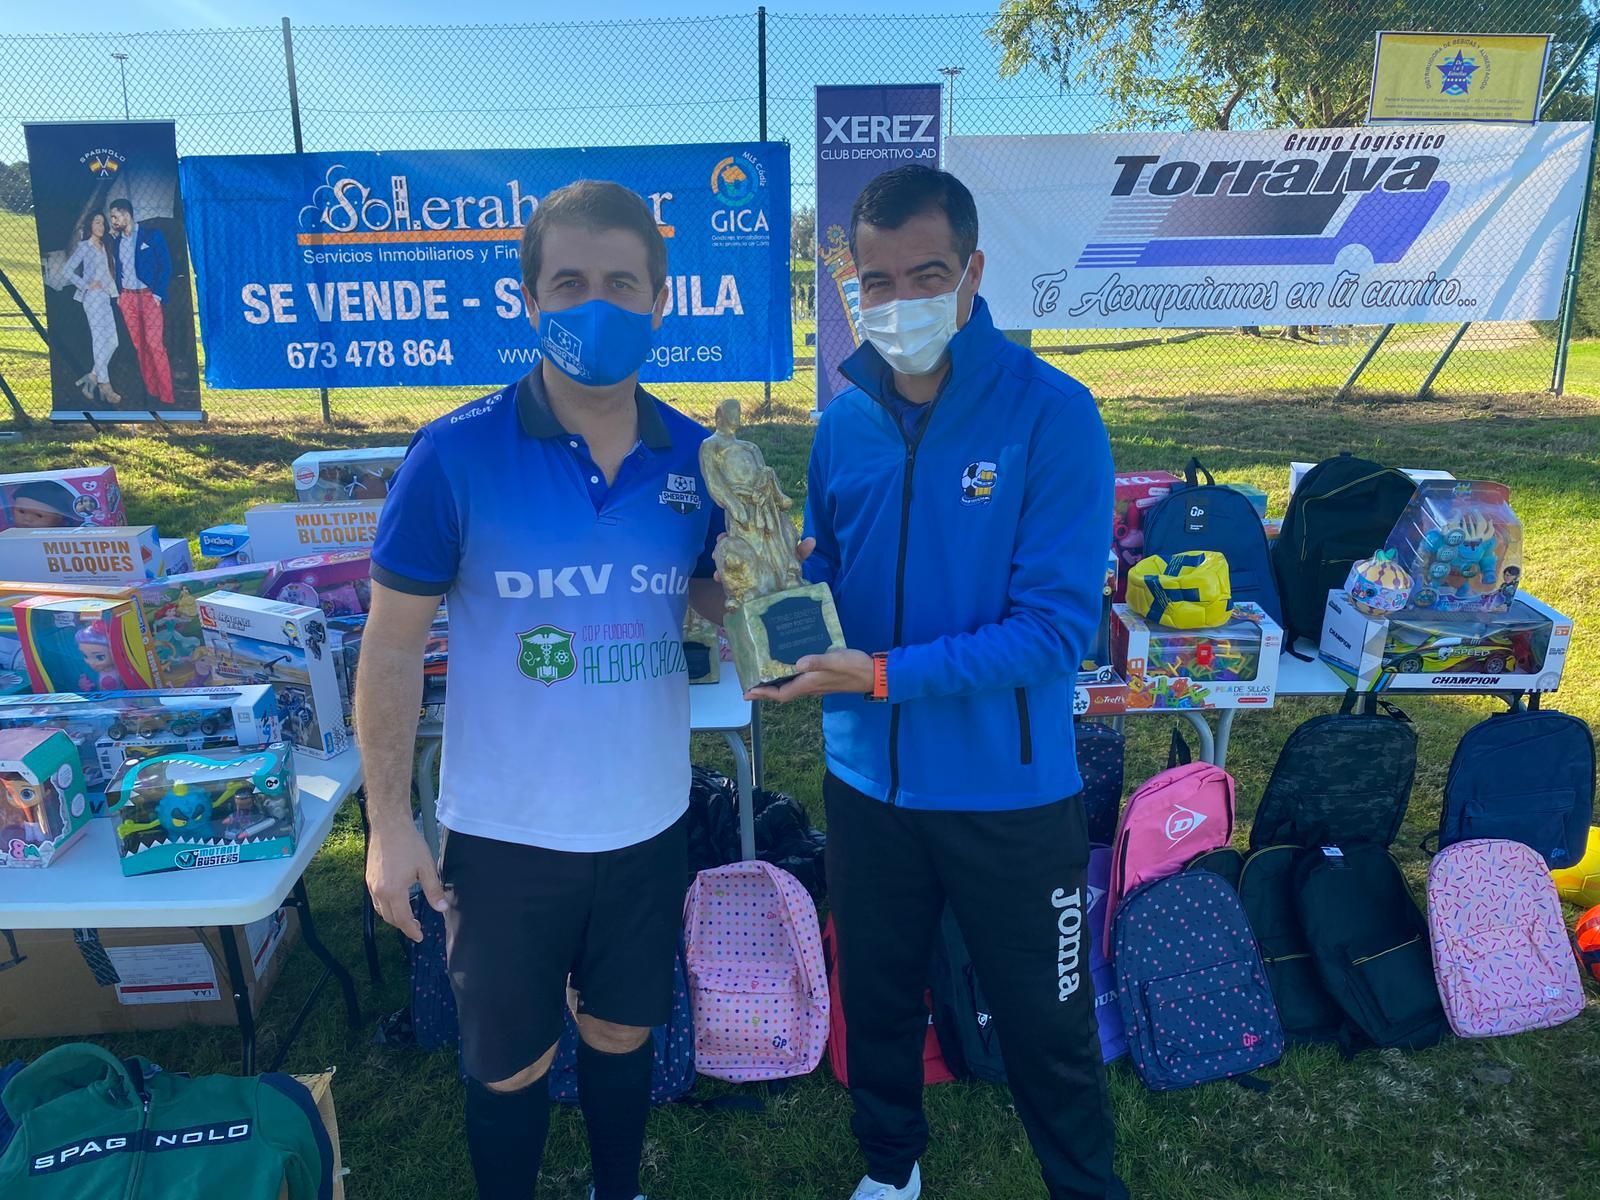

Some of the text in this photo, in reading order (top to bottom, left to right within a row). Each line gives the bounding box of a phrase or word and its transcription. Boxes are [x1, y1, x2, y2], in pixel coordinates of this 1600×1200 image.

[822, 115, 935, 144] XEREZ
[1284, 132, 1446, 152] Grupo Logístico
[820, 148, 937, 160] CLUB DEPORTIVO SAD
[1110, 151, 1441, 197] Torralva
[711, 209, 769, 233] GICA
[303, 247, 373, 264] Servicios
[379, 245, 474, 263] Inmobiliarios
[479, 248, 489, 264] y
[241, 282, 297, 324] SE
[305, 279, 449, 322] VENDE
[494, 277, 530, 319] S
[1032, 268, 1067, 317] Te
[1286, 282, 1325, 309] en
[1361, 271, 1477, 308] camino...
[286, 342, 338, 369] 673
[345, 340, 395, 367] 478
[402, 338, 454, 367] 864
[663, 492, 689, 503] SHERRY
[295, 511, 377, 527] MULTIPIN
[298, 526, 377, 545] BLOQUES
[43, 541, 130, 555] MULTIPIN
[47, 556, 134, 575] BLOQUES
[494, 563, 689, 598] DKV Salu
[1329, 628, 1352, 650] CHAMPION
[583, 642, 647, 685] ALBOR
[1431, 675, 1501, 686] CHAMPION
[1247, 685, 1271, 698] SILLAS
[199, 845, 239, 857] MUTANT
